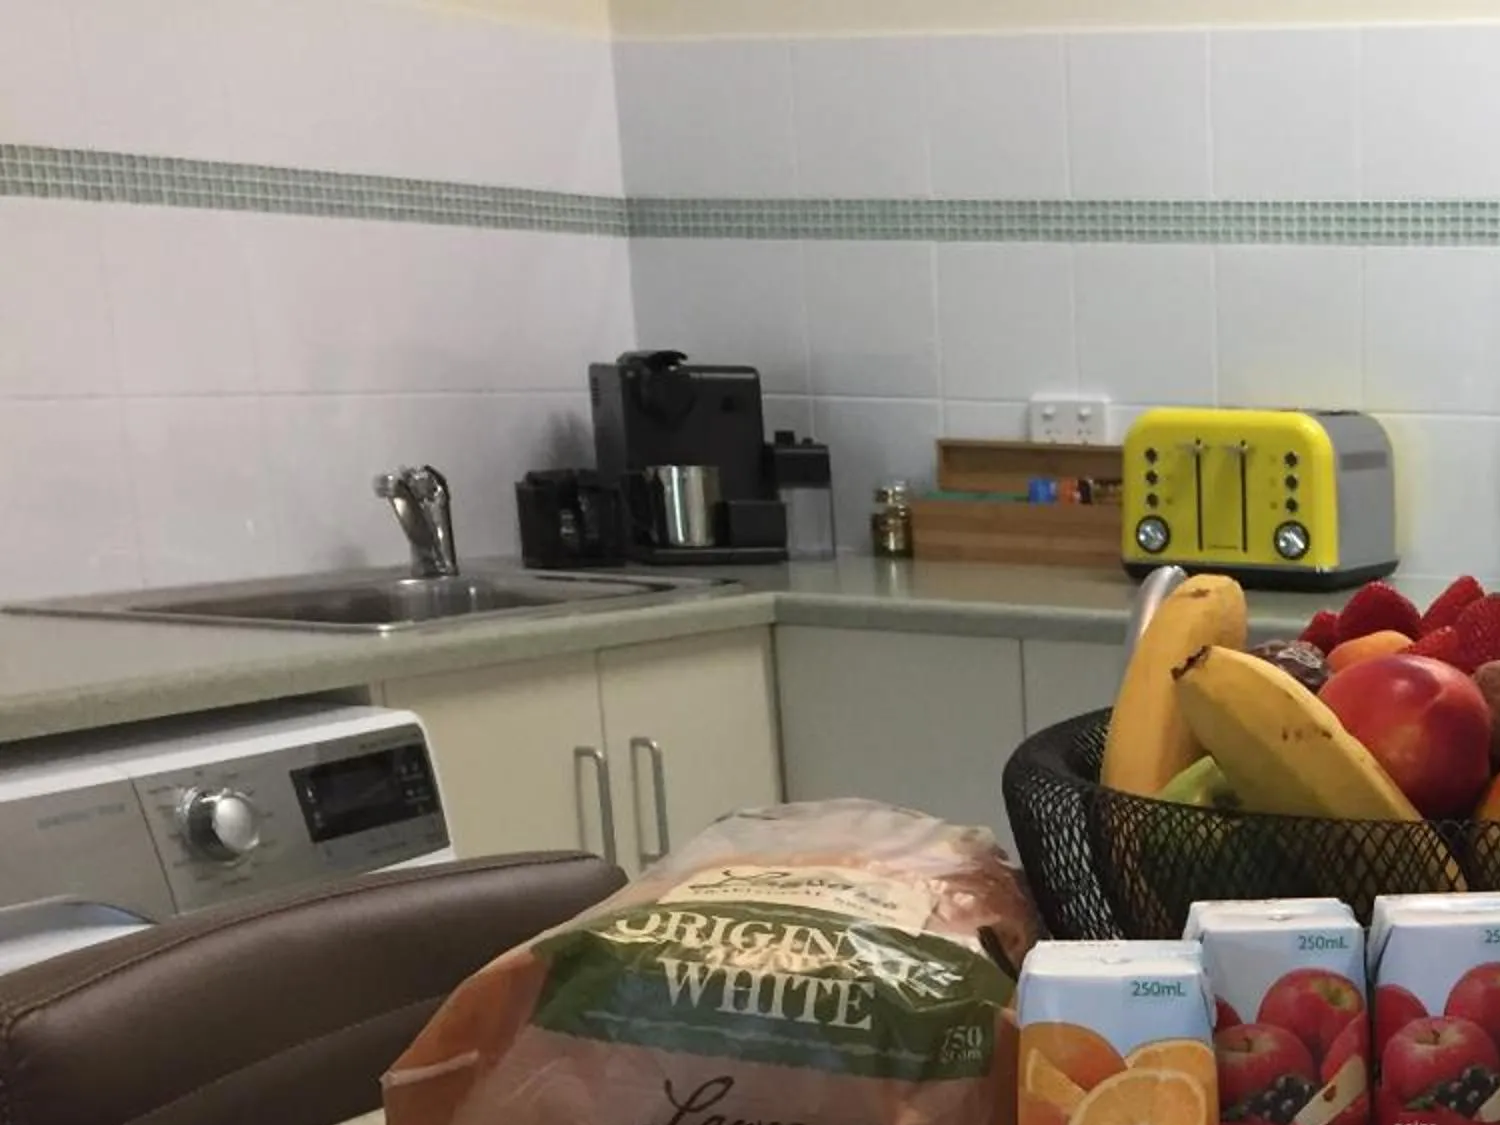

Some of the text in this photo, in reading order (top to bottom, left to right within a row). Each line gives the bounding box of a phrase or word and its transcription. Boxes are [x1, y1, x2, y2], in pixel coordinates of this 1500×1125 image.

[614, 911, 945, 998] ORIGIN
[1298, 935, 1349, 951] 250mL
[657, 956, 875, 1030] WHITE
[1131, 981, 1187, 998] 250mL
